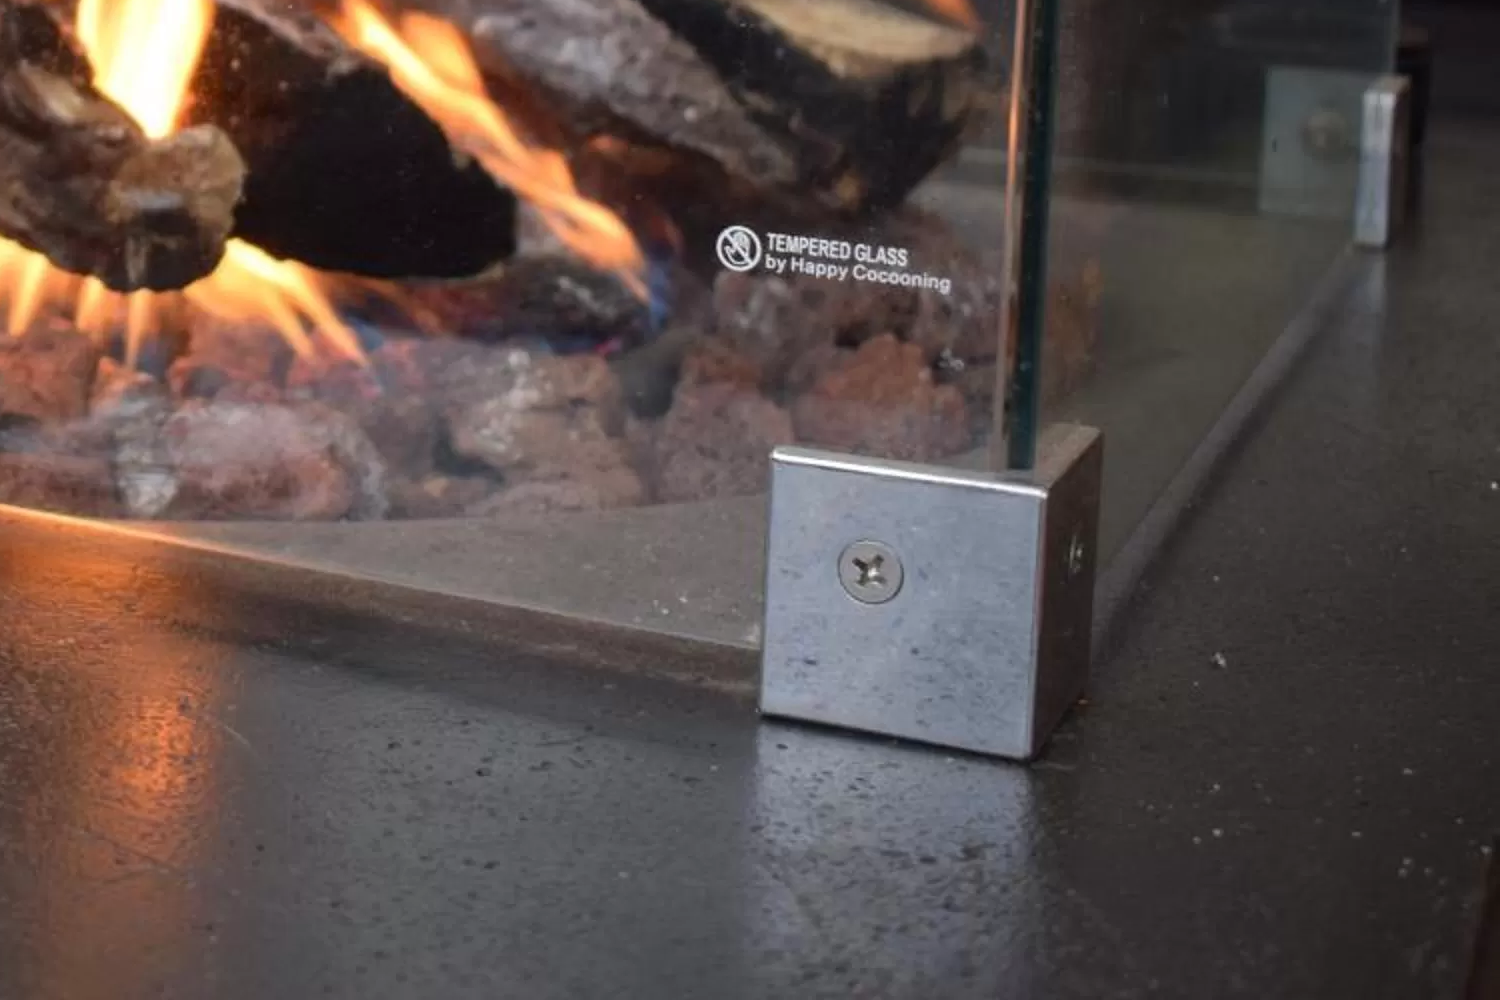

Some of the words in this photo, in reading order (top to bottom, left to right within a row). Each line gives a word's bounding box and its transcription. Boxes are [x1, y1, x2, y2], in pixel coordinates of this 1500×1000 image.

[767, 232, 850, 260] TEMPERED
[854, 243, 909, 267] GLASS
[764, 254, 787, 273] by
[790, 257, 848, 281] Happy
[852, 264, 952, 294] Cocooning
